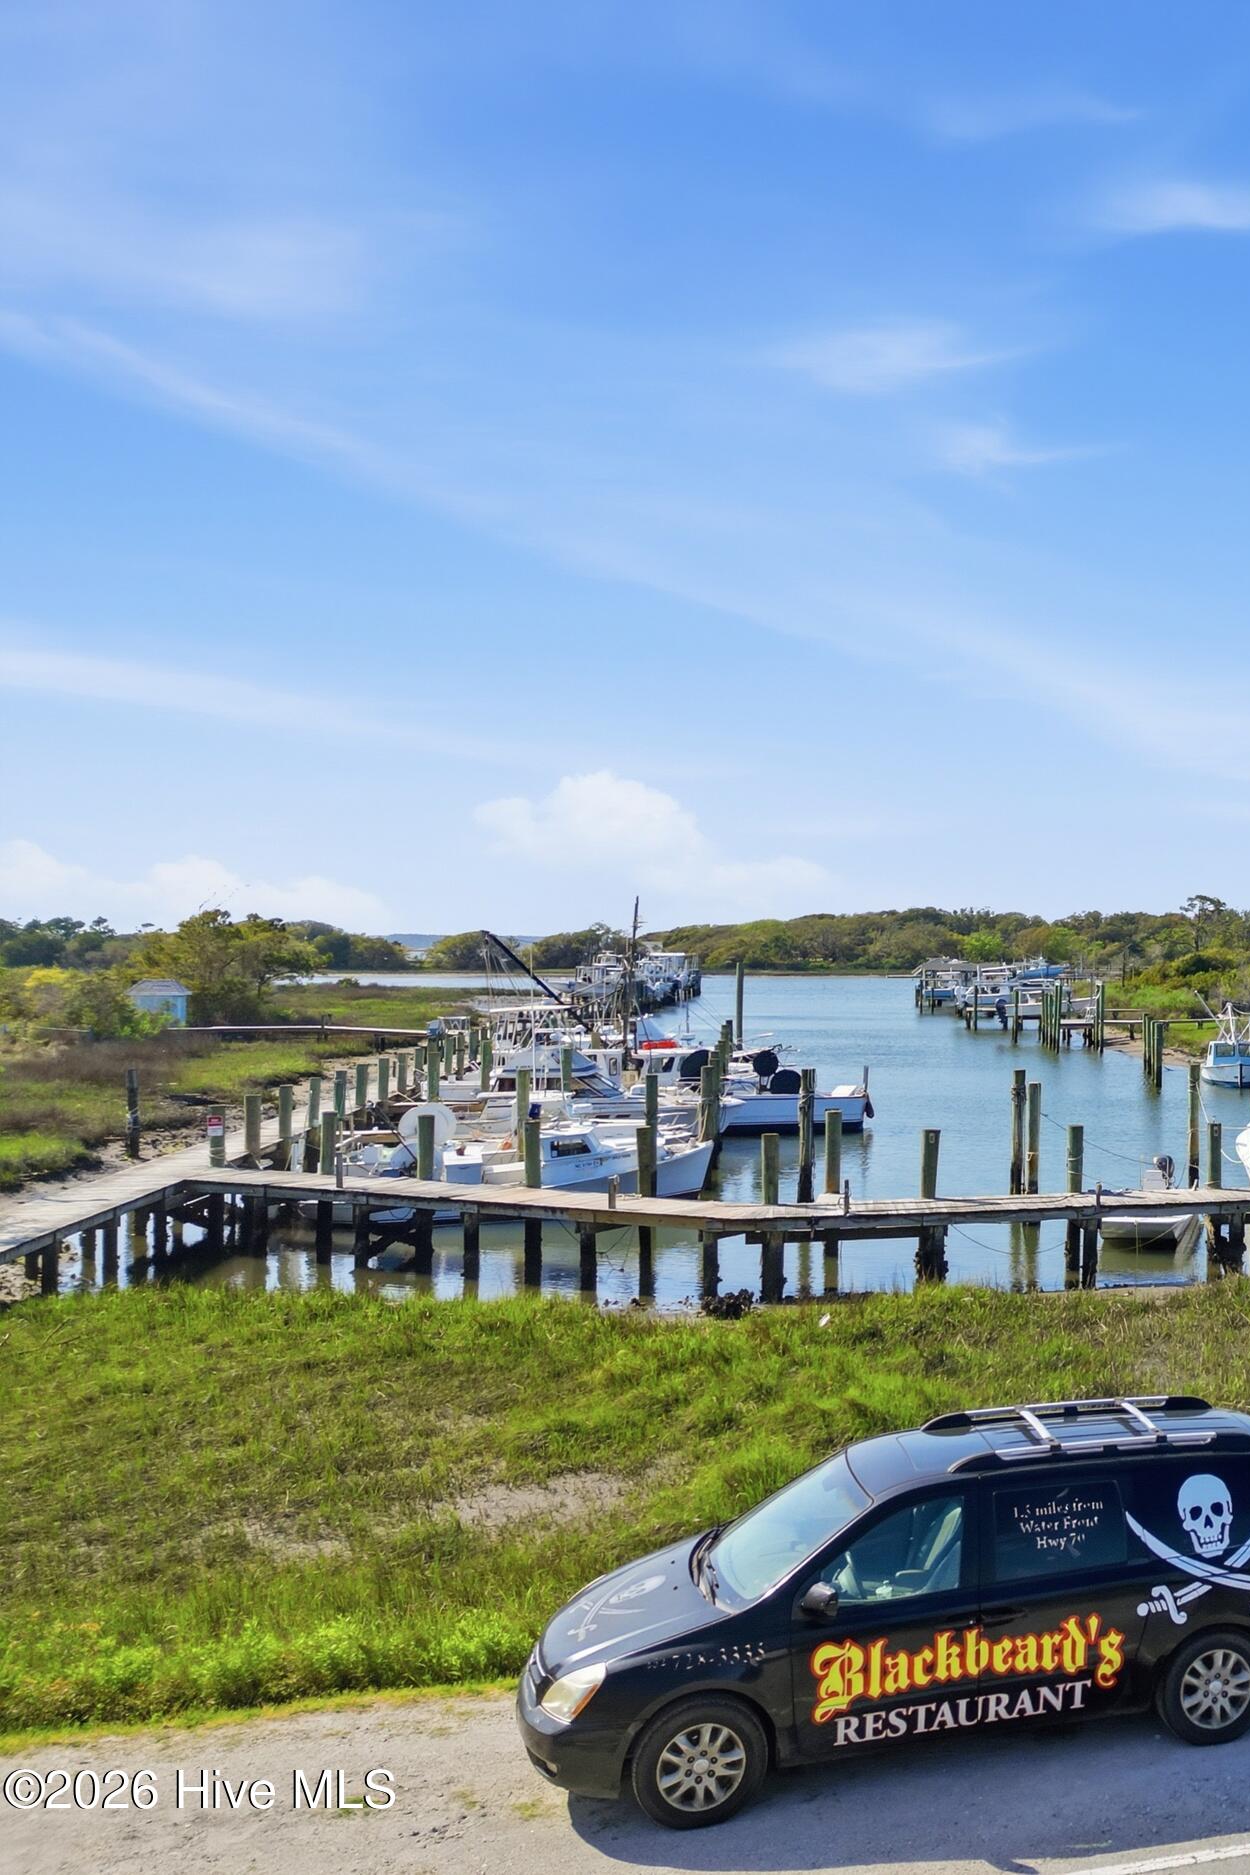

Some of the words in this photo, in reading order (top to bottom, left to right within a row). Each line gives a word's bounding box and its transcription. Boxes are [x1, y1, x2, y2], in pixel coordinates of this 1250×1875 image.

[1035, 1501, 1068, 1516] miles
[1072, 1498, 1104, 1512] from
[1019, 1520, 1060, 1533] Water
[1063, 1516, 1098, 1529] Front
[1036, 1536, 1066, 1550] Hwy
[810, 1612, 1126, 1725] Blackbeard's
[832, 1679, 1093, 1747] RESTAURANT
